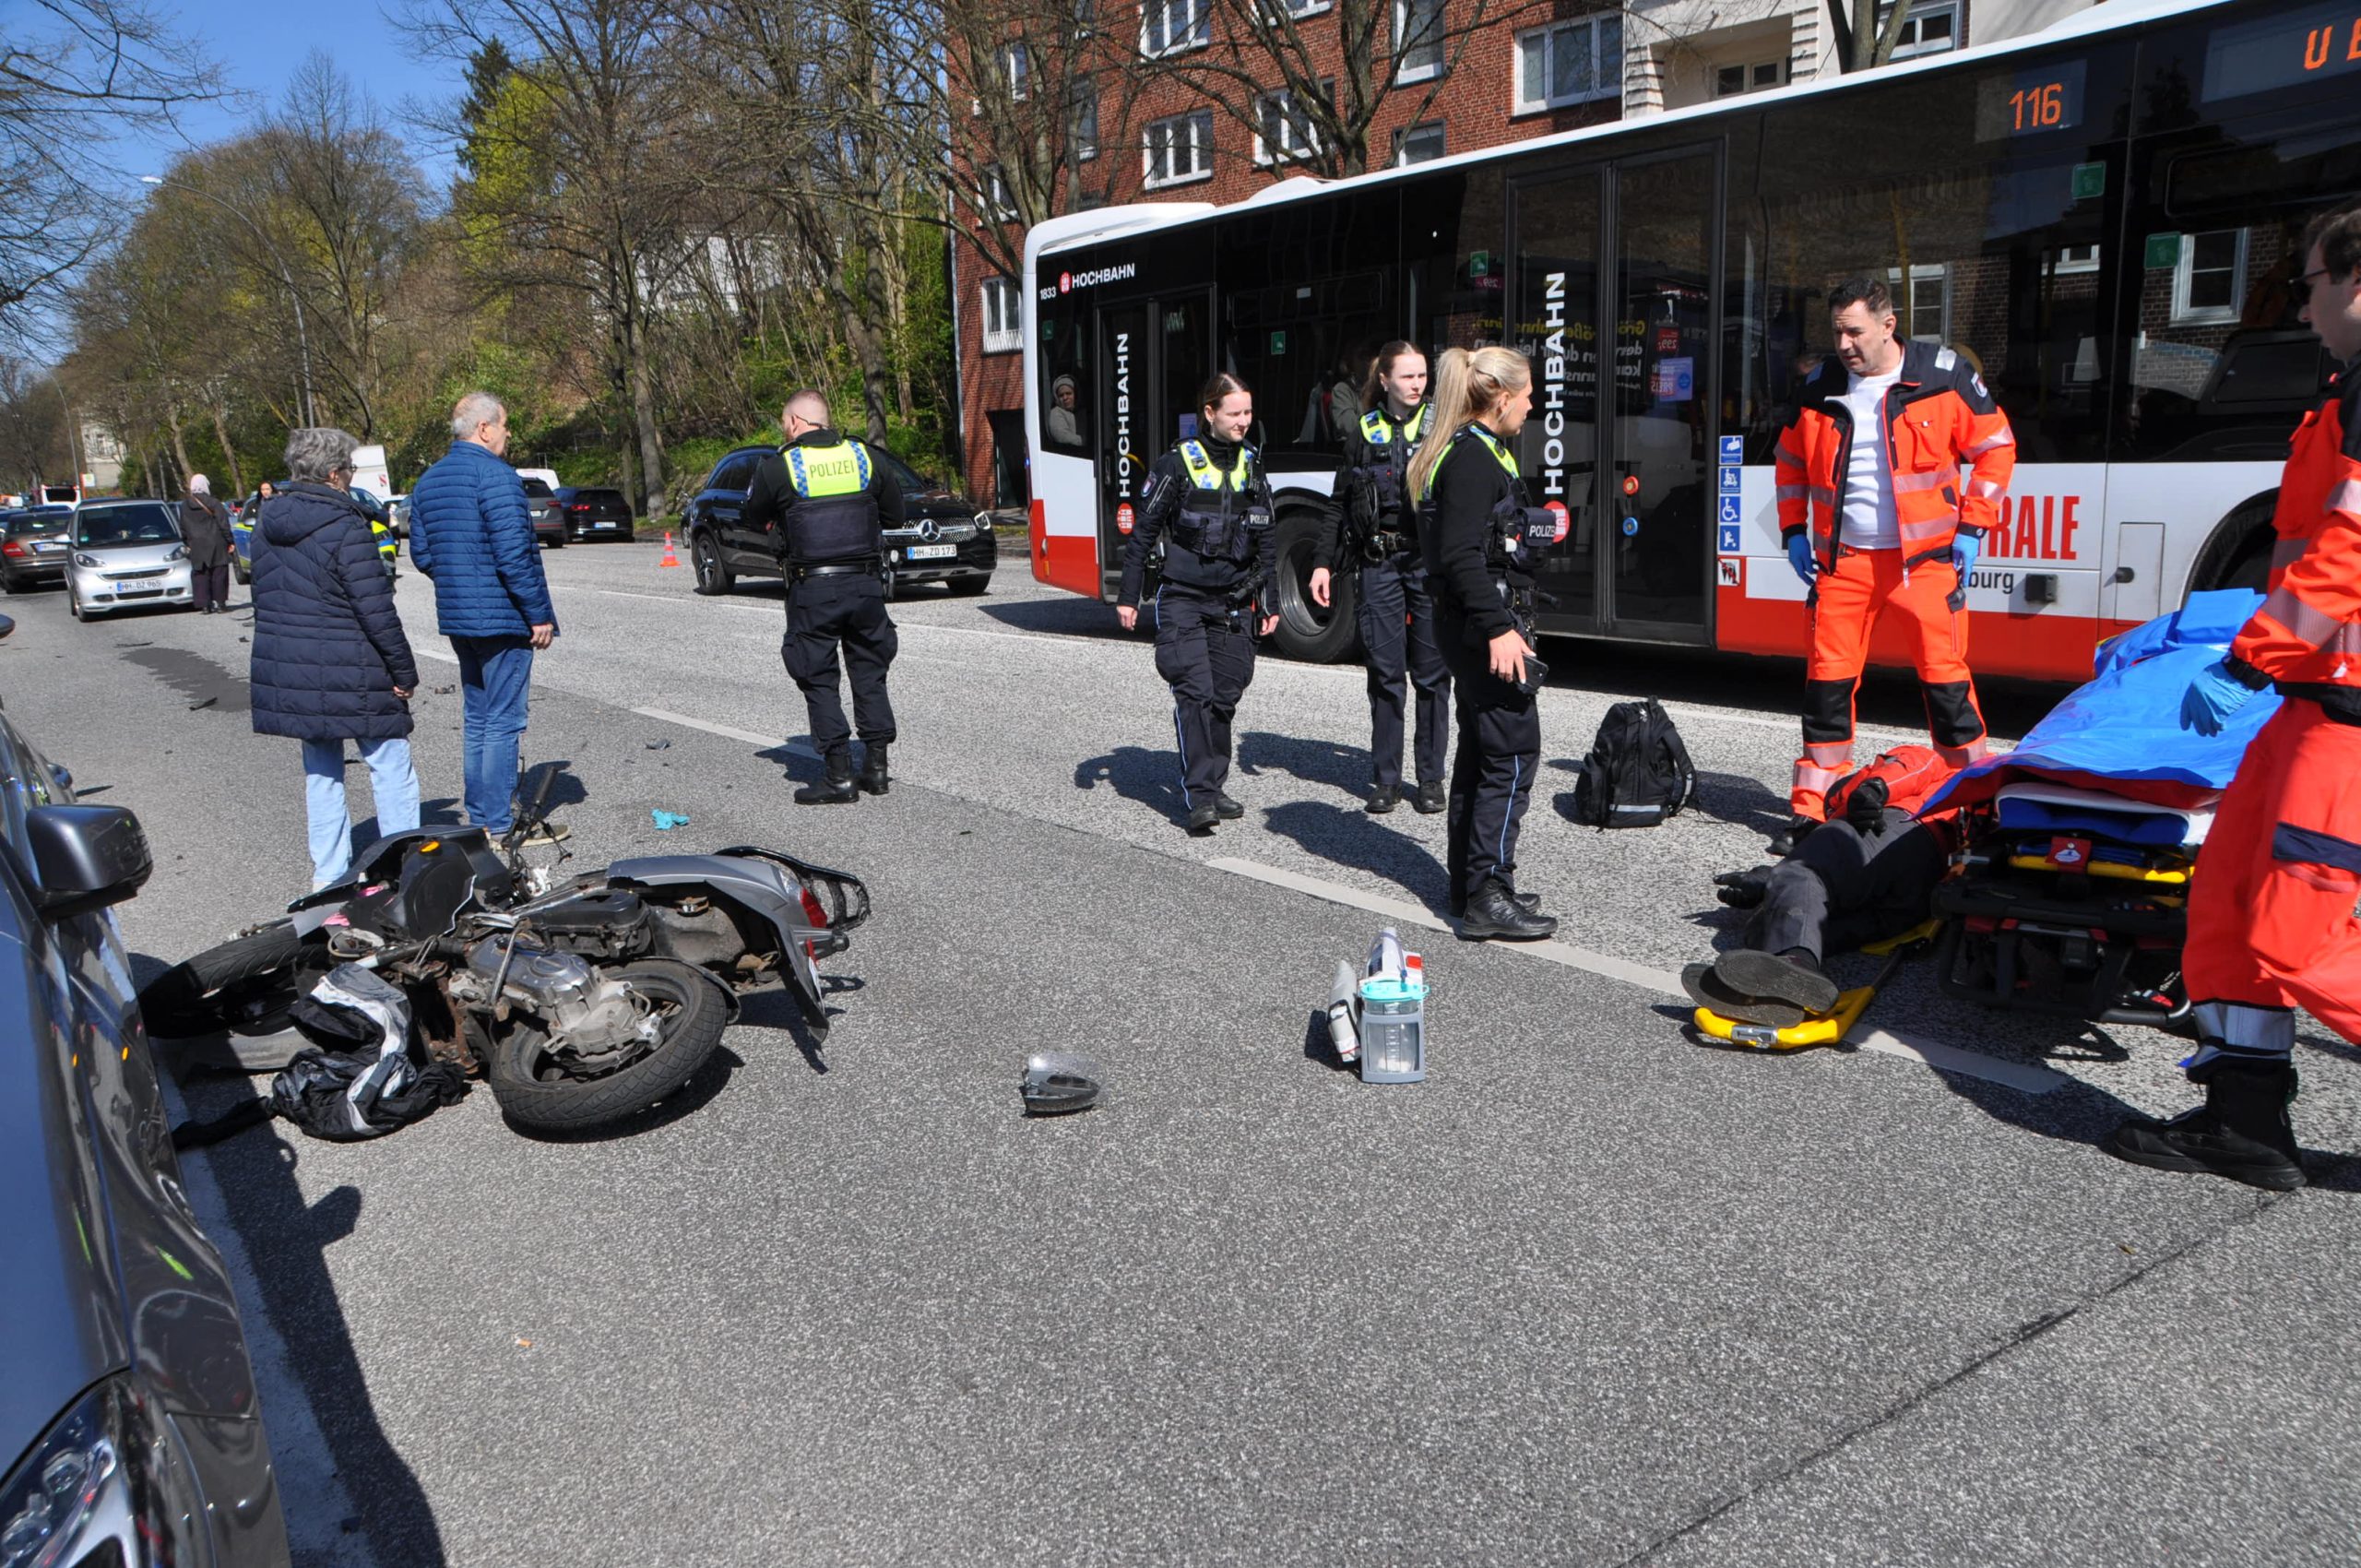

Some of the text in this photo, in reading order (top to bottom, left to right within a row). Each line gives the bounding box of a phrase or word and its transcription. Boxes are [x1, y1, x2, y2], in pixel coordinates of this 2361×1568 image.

[2304, 25, 2332, 70] U
[2009, 83, 2063, 130] 116
[1072, 263, 1135, 289] HOCHBAHN
[1039, 286, 1057, 301] 1833
[1544, 272, 1565, 494] HOCHBAHN
[1117, 333, 1131, 497] HOCHBAHN
[809, 459, 855, 478] POLIZEI
[1529, 525, 1556, 537] POLIZE
[1976, 495, 2080, 560] RALE
[942, 545, 956, 555] 173
[1959, 570, 2014, 595] burg
